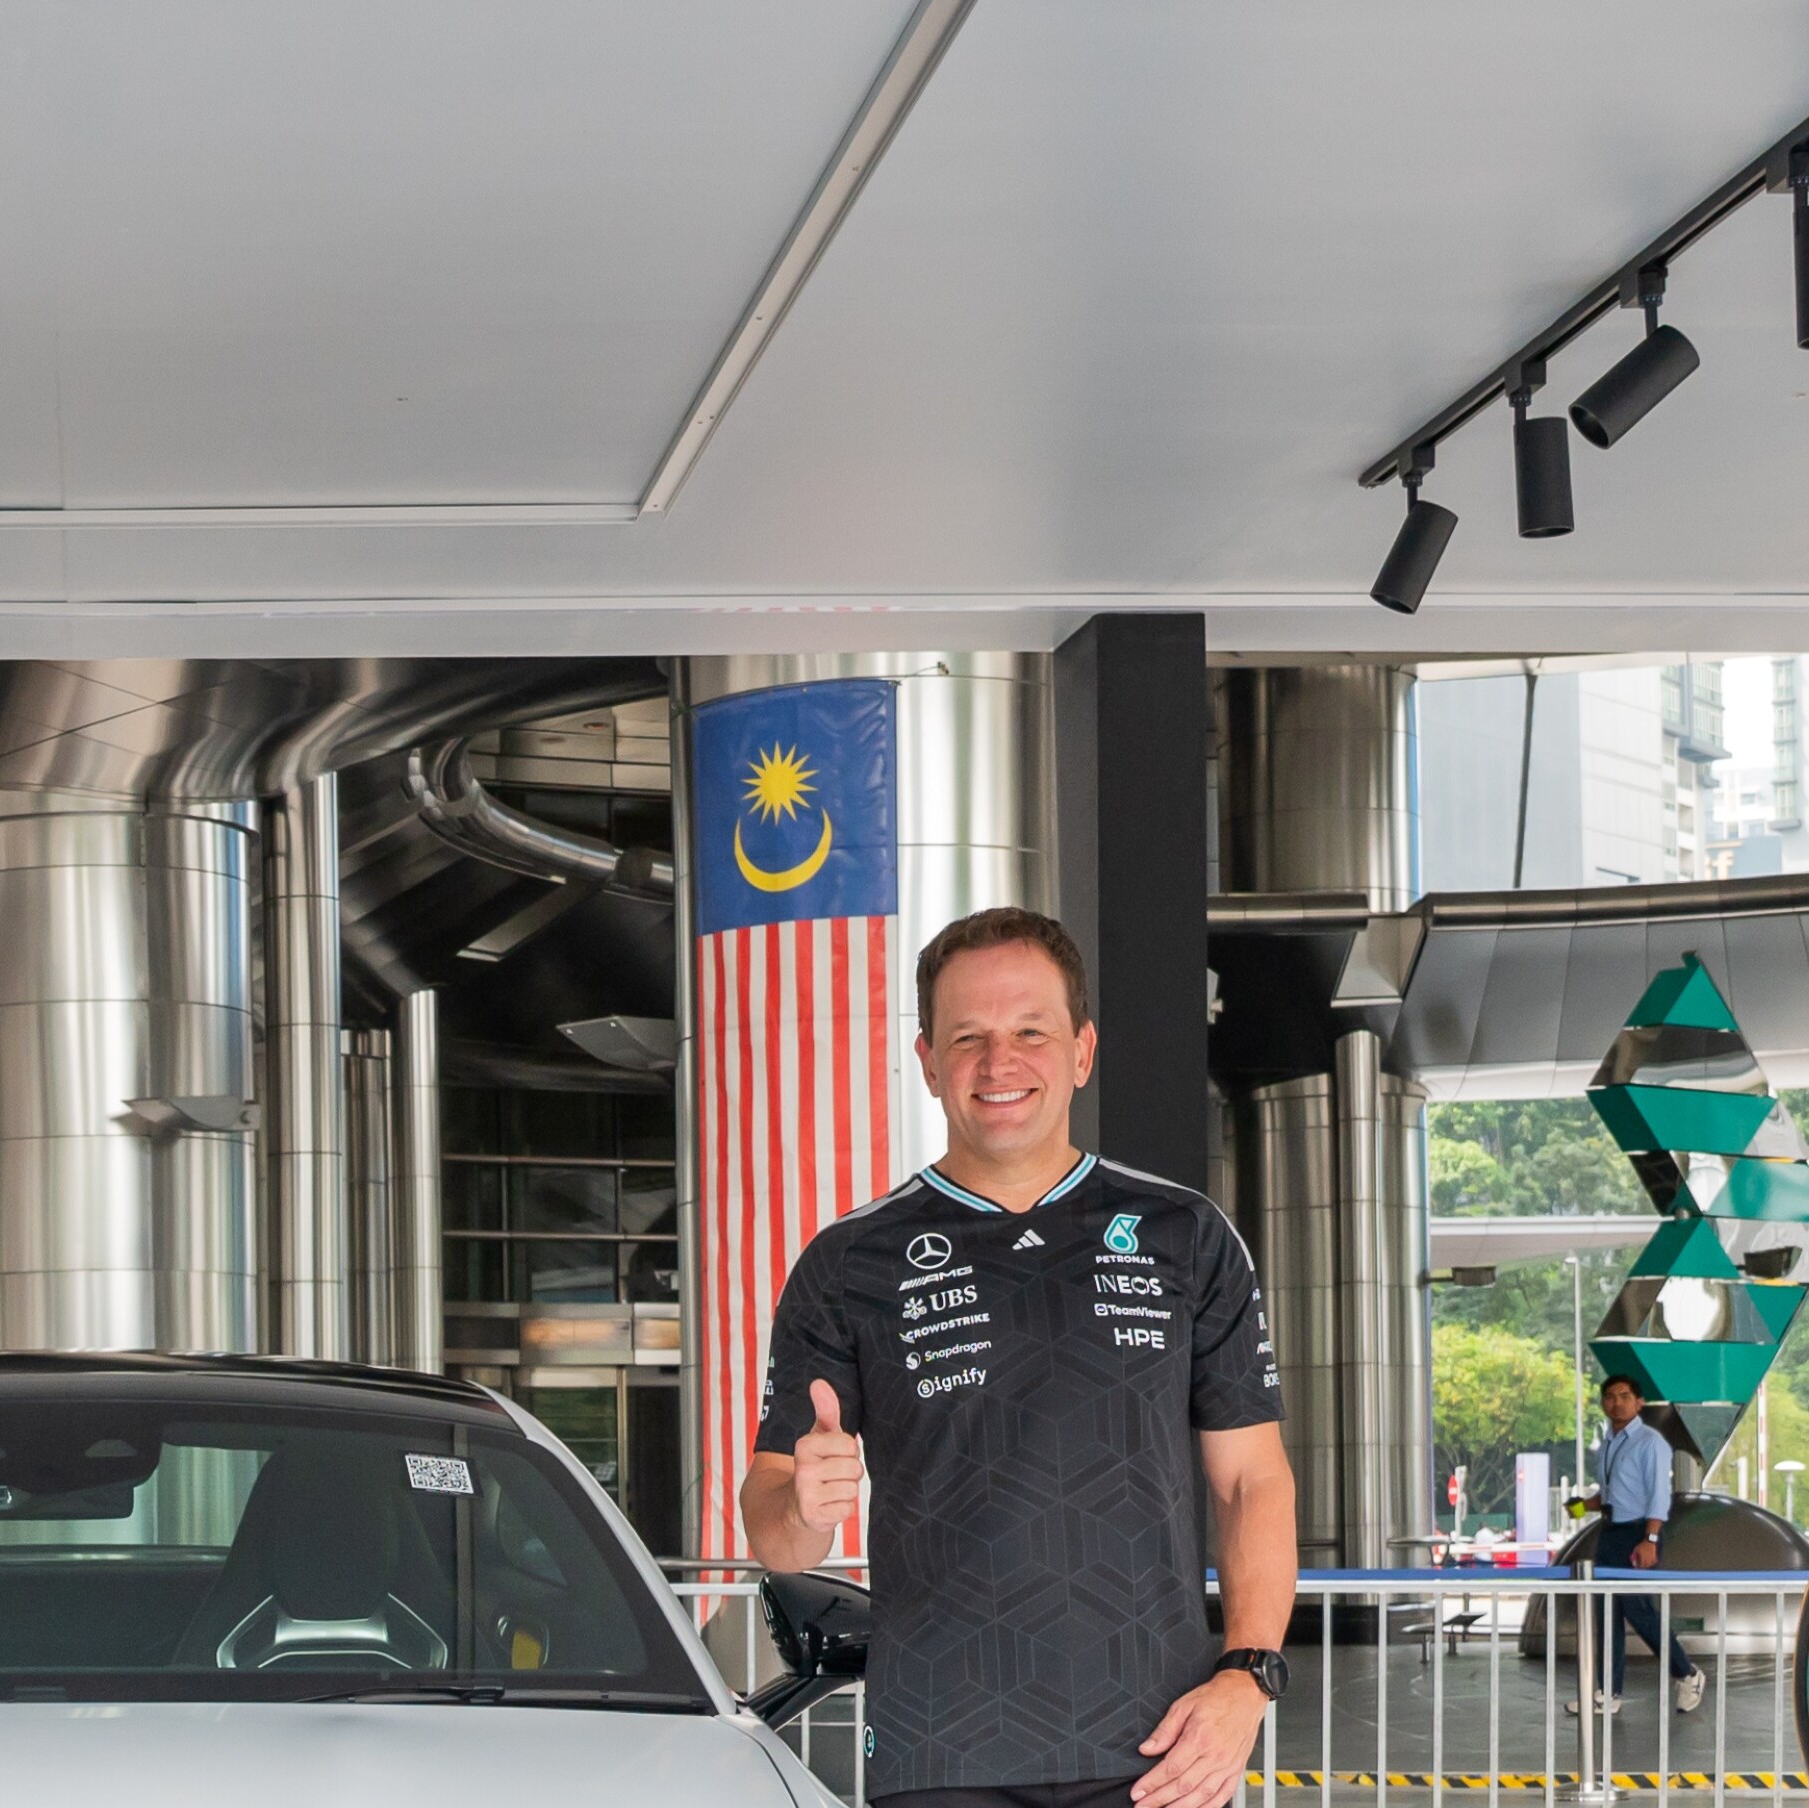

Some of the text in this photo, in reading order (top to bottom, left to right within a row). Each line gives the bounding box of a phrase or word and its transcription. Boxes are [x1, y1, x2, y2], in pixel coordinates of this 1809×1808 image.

[1095, 1255, 1155, 1265] PETRONAS
[924, 1265, 973, 1285] AMG
[1094, 1274, 1163, 1296] INEOS
[929, 1285, 978, 1312] UBS
[1108, 1304, 1172, 1320] TeamViewer
[906, 1313, 991, 1339] CROWDSTRIKE
[1114, 1327, 1165, 1349] HPE
[924, 1340, 992, 1361] Snapdragon
